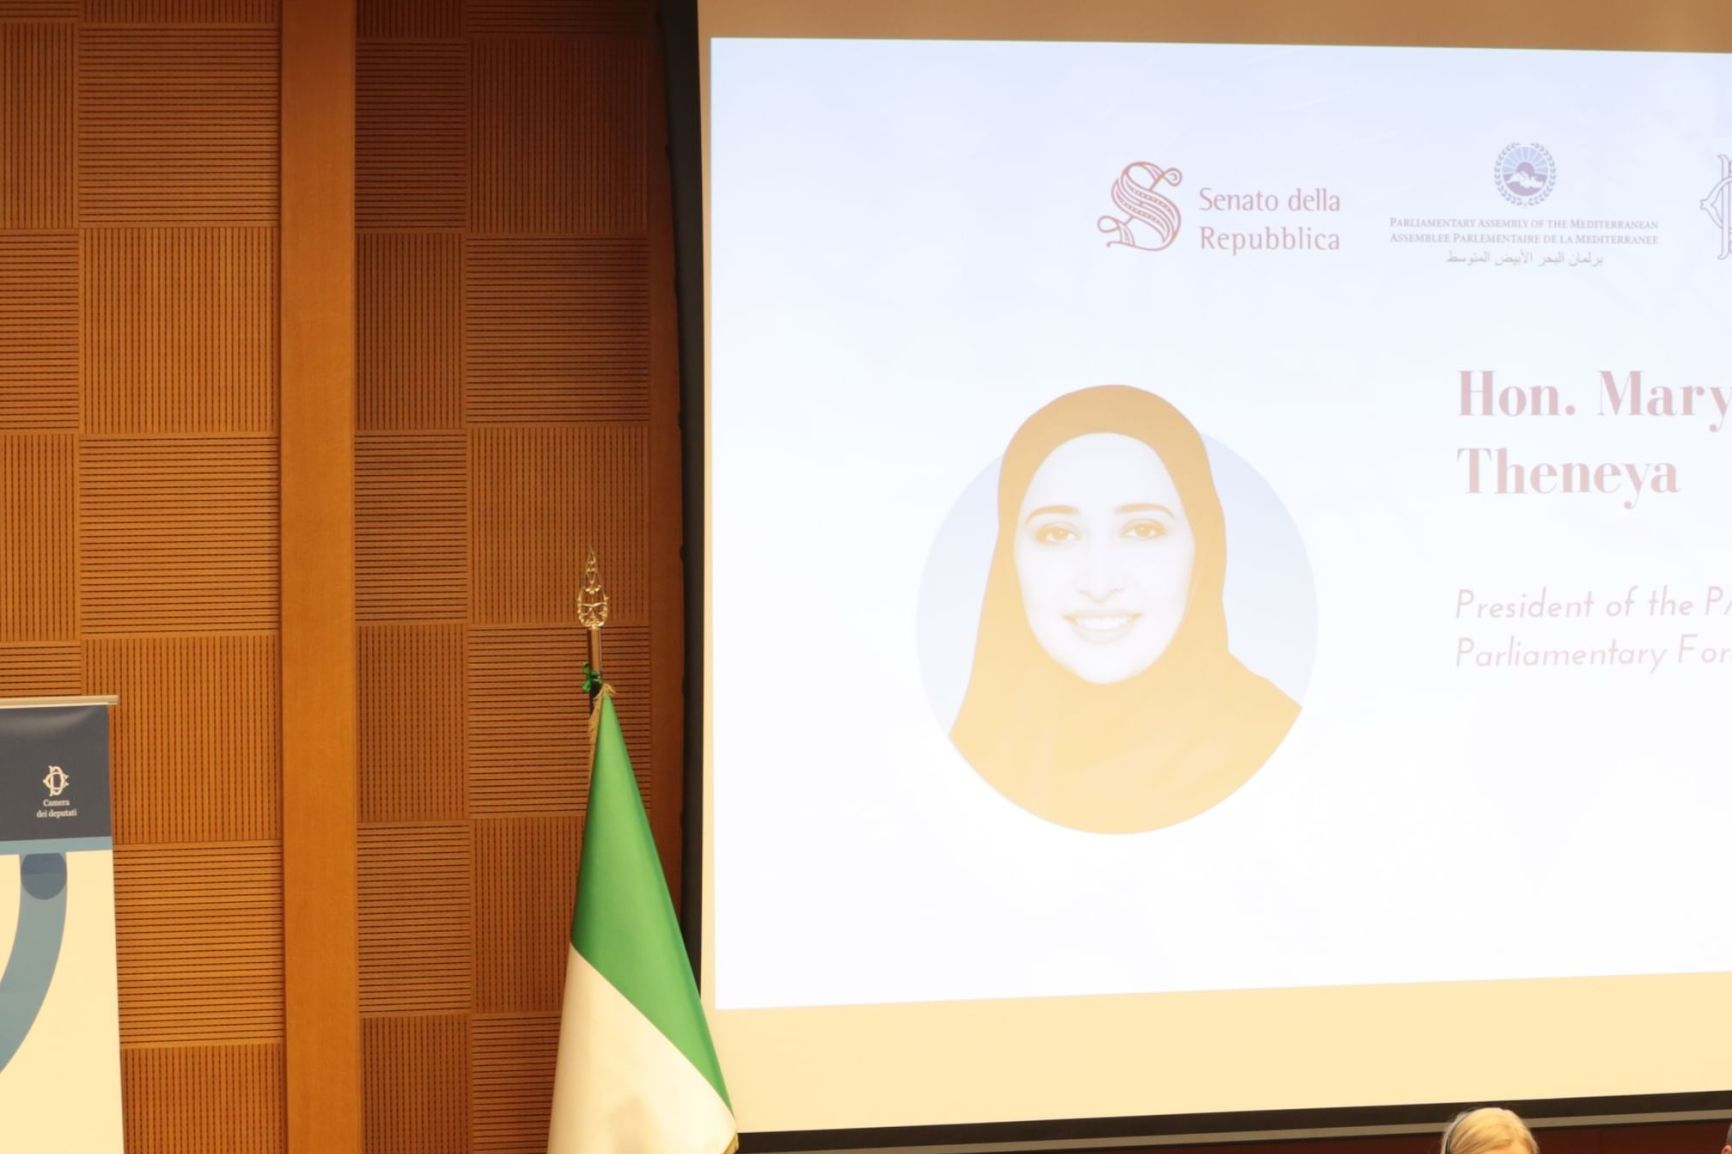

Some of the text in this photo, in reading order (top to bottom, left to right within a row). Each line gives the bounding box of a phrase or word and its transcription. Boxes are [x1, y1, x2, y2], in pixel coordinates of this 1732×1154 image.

[1198, 187, 1341, 212] Senato della
[1389, 217, 1659, 230] PARLIAMENTARY ASSEMBLY OF THE MEDITERRANEAN
[1199, 226, 1341, 256] Repubblica
[1457, 369, 1576, 417] Hon.
[1456, 446, 1682, 510] Theneya
[1455, 586, 1595, 619] President
[1605, 585, 1639, 617] of
[1648, 585, 1695, 616] the
[1455, 635, 1667, 675] Parliamentary
[36, 808, 78, 819] dei deputati
[43, 799, 70, 807] Camera
